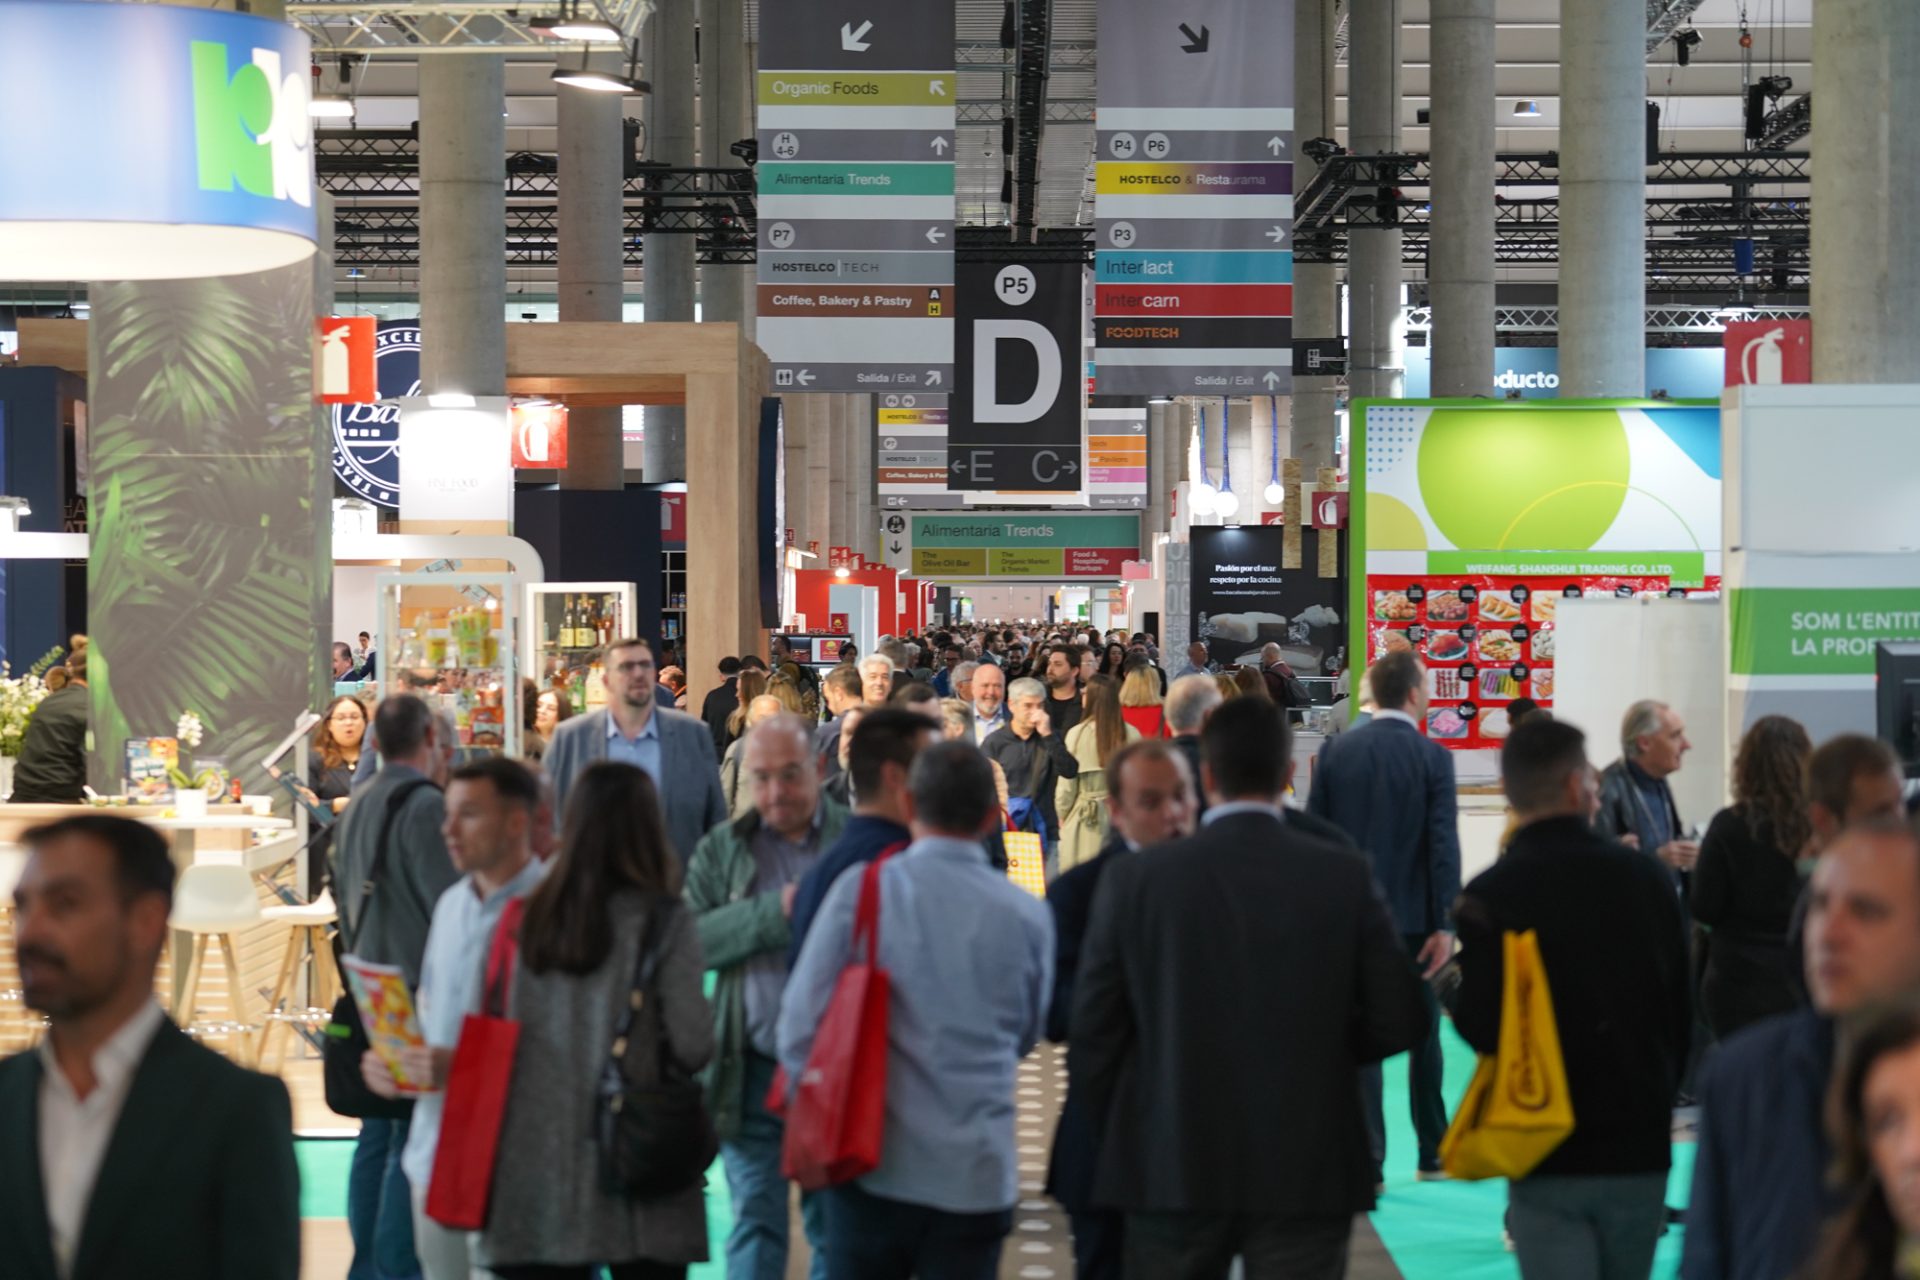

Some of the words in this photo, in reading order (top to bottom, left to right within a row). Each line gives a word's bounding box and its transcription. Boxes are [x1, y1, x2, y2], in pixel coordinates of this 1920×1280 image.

[772, 80, 830, 98] Organic
[833, 81, 879, 95] Foods
[781, 134, 790, 144] H
[777, 146, 794, 156] 4-6
[1114, 140, 1131, 151] P4
[1148, 140, 1165, 151] P6
[775, 173, 844, 184] Alimentaria
[848, 173, 891, 185] Trends
[1119, 175, 1181, 185] HOSTELCO
[1185, 175, 1192, 185] &
[1196, 174, 1266, 185] Restaurama
[773, 229, 790, 241] P7
[1114, 230, 1131, 241] P3
[772, 263, 835, 272] HOSTELCO
[842, 263, 879, 272] TECH
[1105, 259, 1174, 275] Interlact
[1002, 277, 1028, 294] P5
[930, 289, 939, 299] A
[772, 295, 816, 307] Coffee,
[819, 295, 859, 308] Bakery
[863, 296, 872, 306] &
[874, 296, 912, 309] Pastry
[1105, 293, 1180, 307] Intercarn
[930, 305, 938, 314] H
[1105, 327, 1179, 338] FOODTECH
[973, 319, 1062, 423] D
[857, 373, 889, 383] Salida
[897, 373, 916, 383] Exit
[1194, 376, 1227, 385] Salida
[1235, 376, 1254, 385] Exit
[970, 450, 995, 482] E
[1031, 450, 1060, 483] C
[921, 524, 1001, 537] Alimentaria
[1003, 523, 1054, 537] Trends
[921, 559, 942, 567] Olive
[943, 559, 954, 567] Oil
[955, 559, 970, 567] Bar
[1073, 558, 1109, 566] Hospitality
[1073, 565, 1102, 573] Startups
[1215, 564, 1239, 572] Pasión
[1466, 564, 1517, 574] WEIFANG
[1519, 564, 1576, 574] SHANSHUI
[1579, 564, 1628, 574] TRADING
[1210, 577, 1236, 585] respeto
[1236, 577, 1249, 585] por
[1791, 612, 1840, 630] SOM
[1792, 638, 1817, 655] LA
